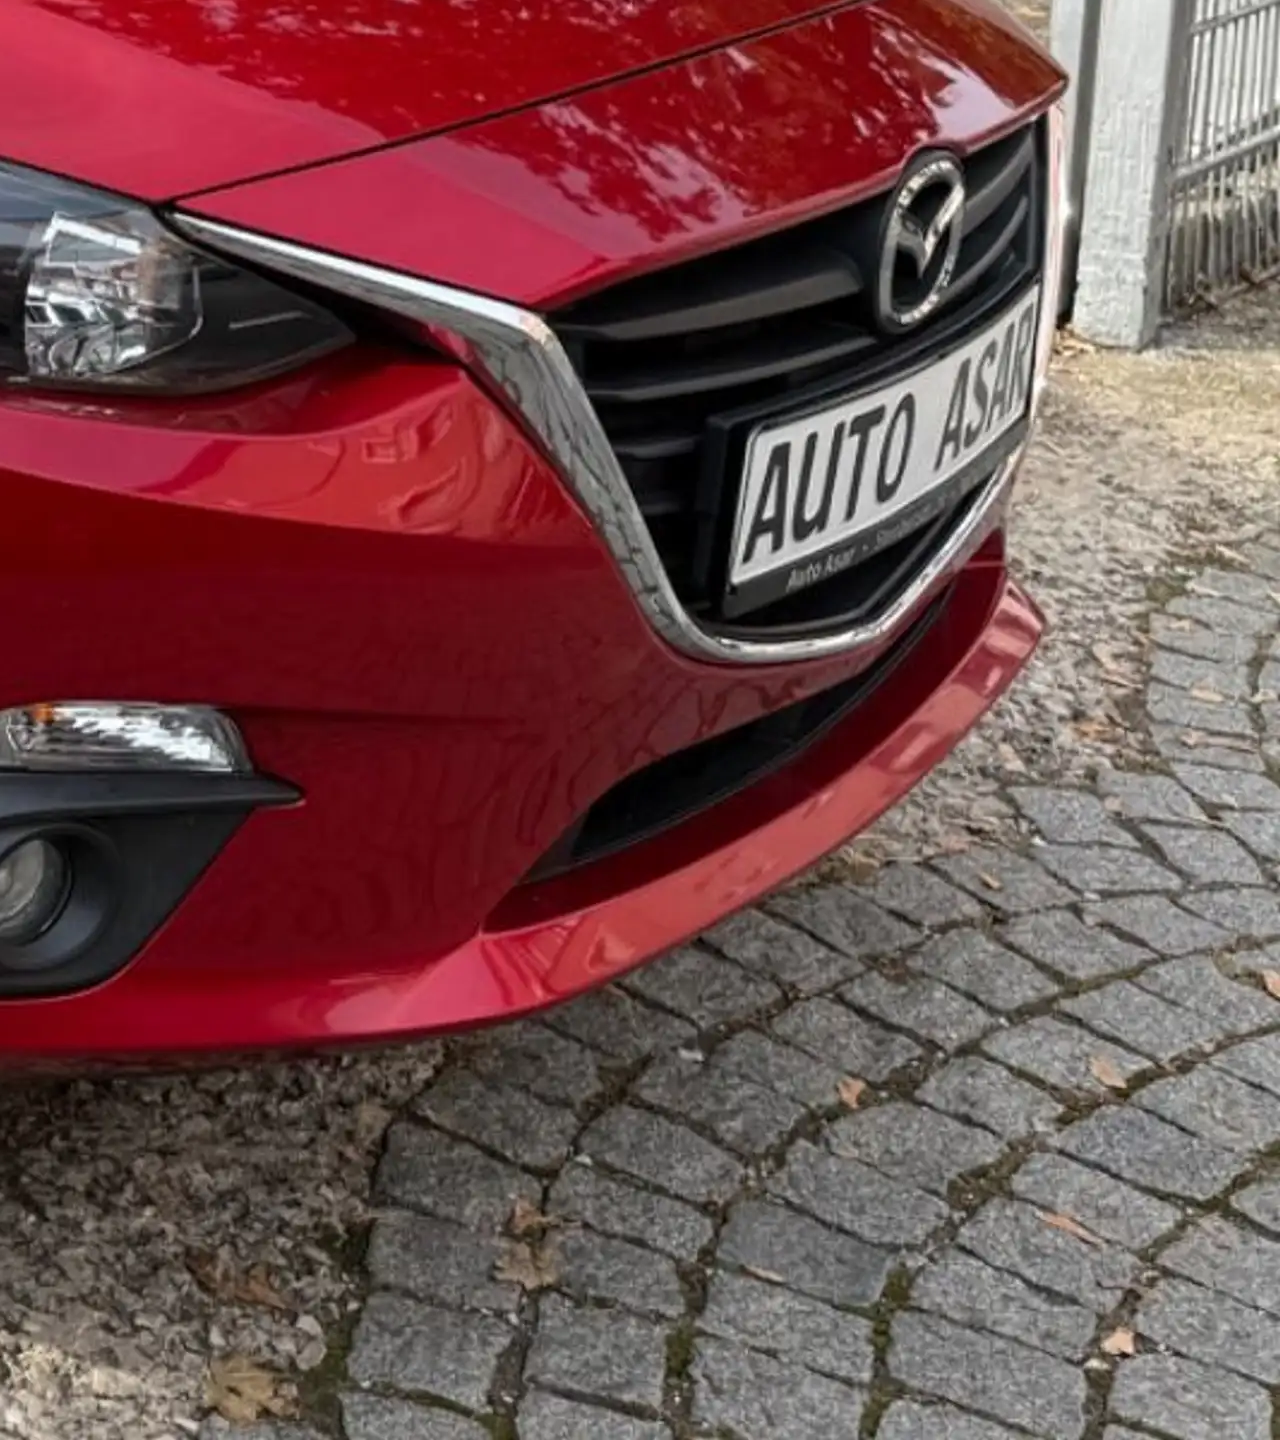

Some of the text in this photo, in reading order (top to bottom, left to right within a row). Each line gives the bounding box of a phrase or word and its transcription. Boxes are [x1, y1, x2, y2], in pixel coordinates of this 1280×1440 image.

[743, 392, 917, 564] AUTO
[934, 307, 1036, 472] ASAR
[786, 562, 823, 593] Auto
